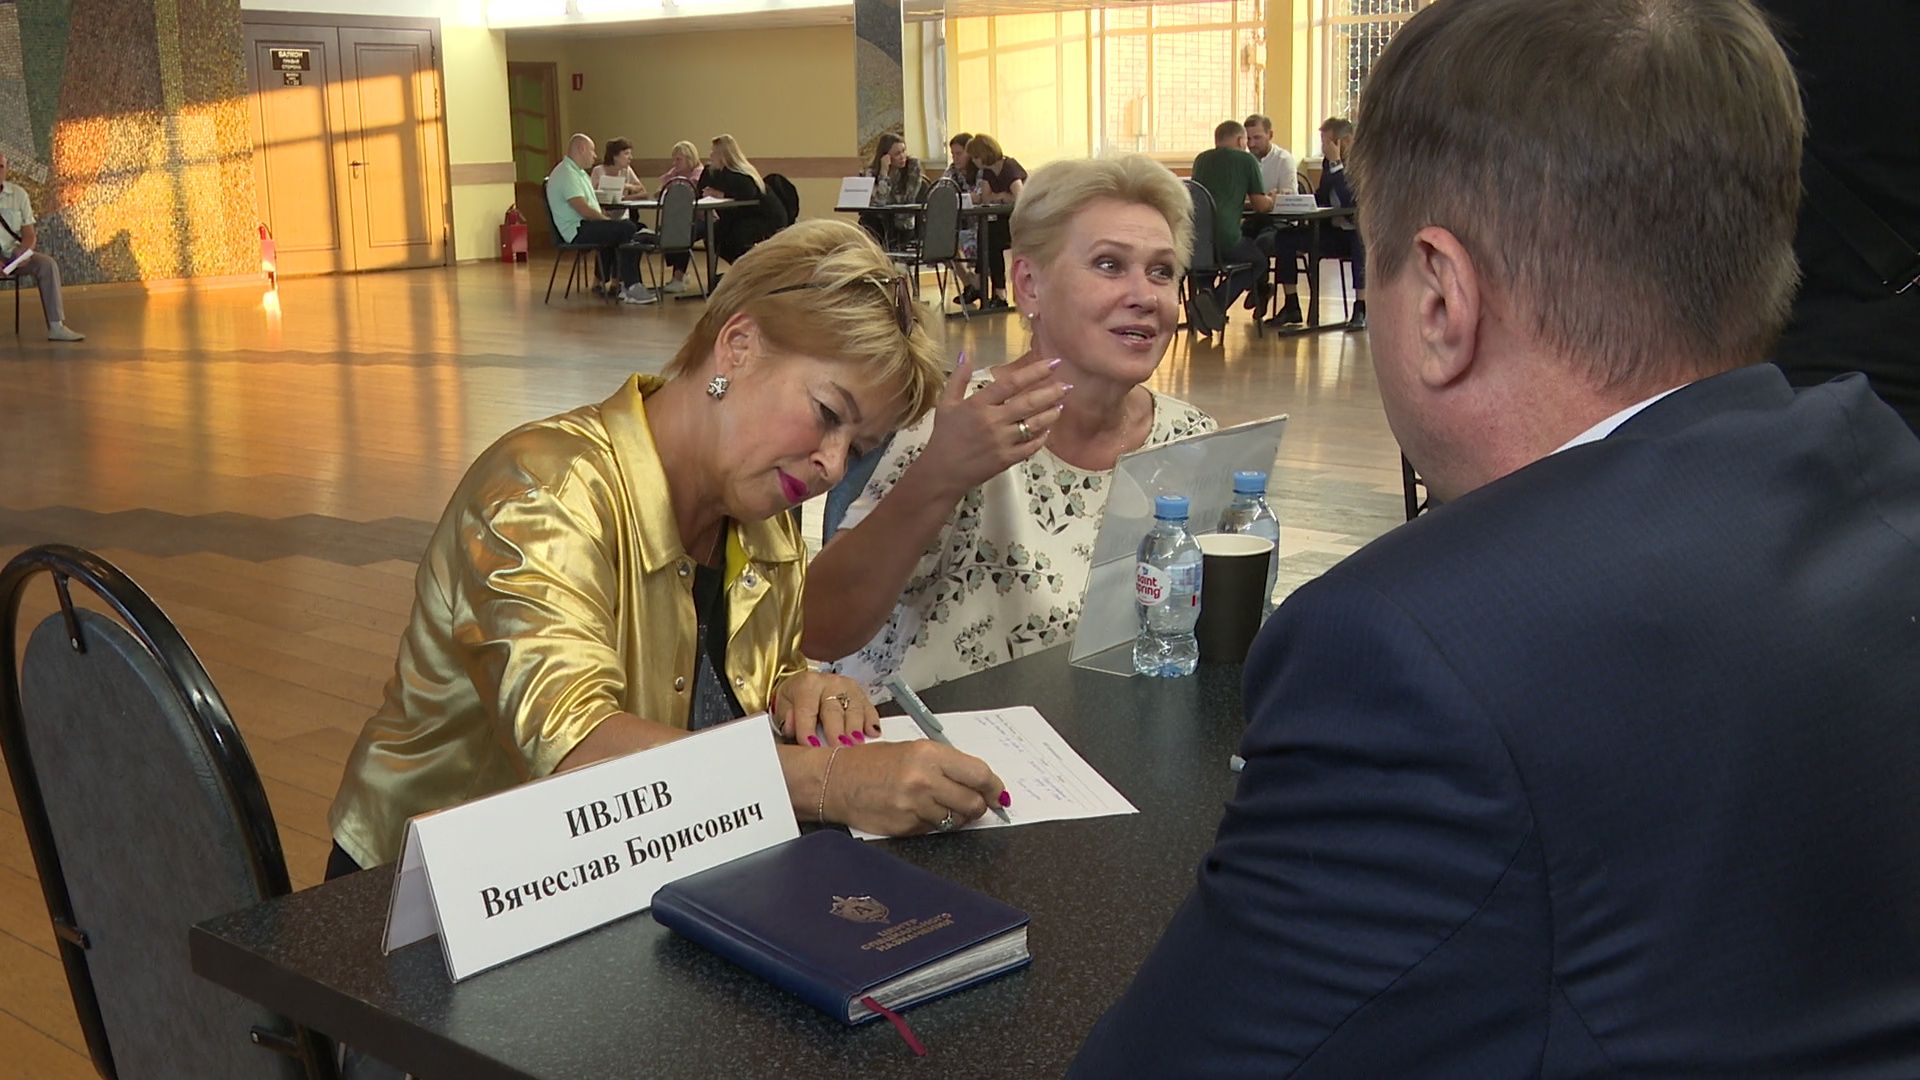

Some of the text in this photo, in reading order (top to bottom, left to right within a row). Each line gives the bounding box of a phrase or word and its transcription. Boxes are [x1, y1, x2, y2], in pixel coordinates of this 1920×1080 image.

[564, 780, 673, 839] ИВЛЕВ
[480, 801, 764, 919] Вячеслав Борисович
